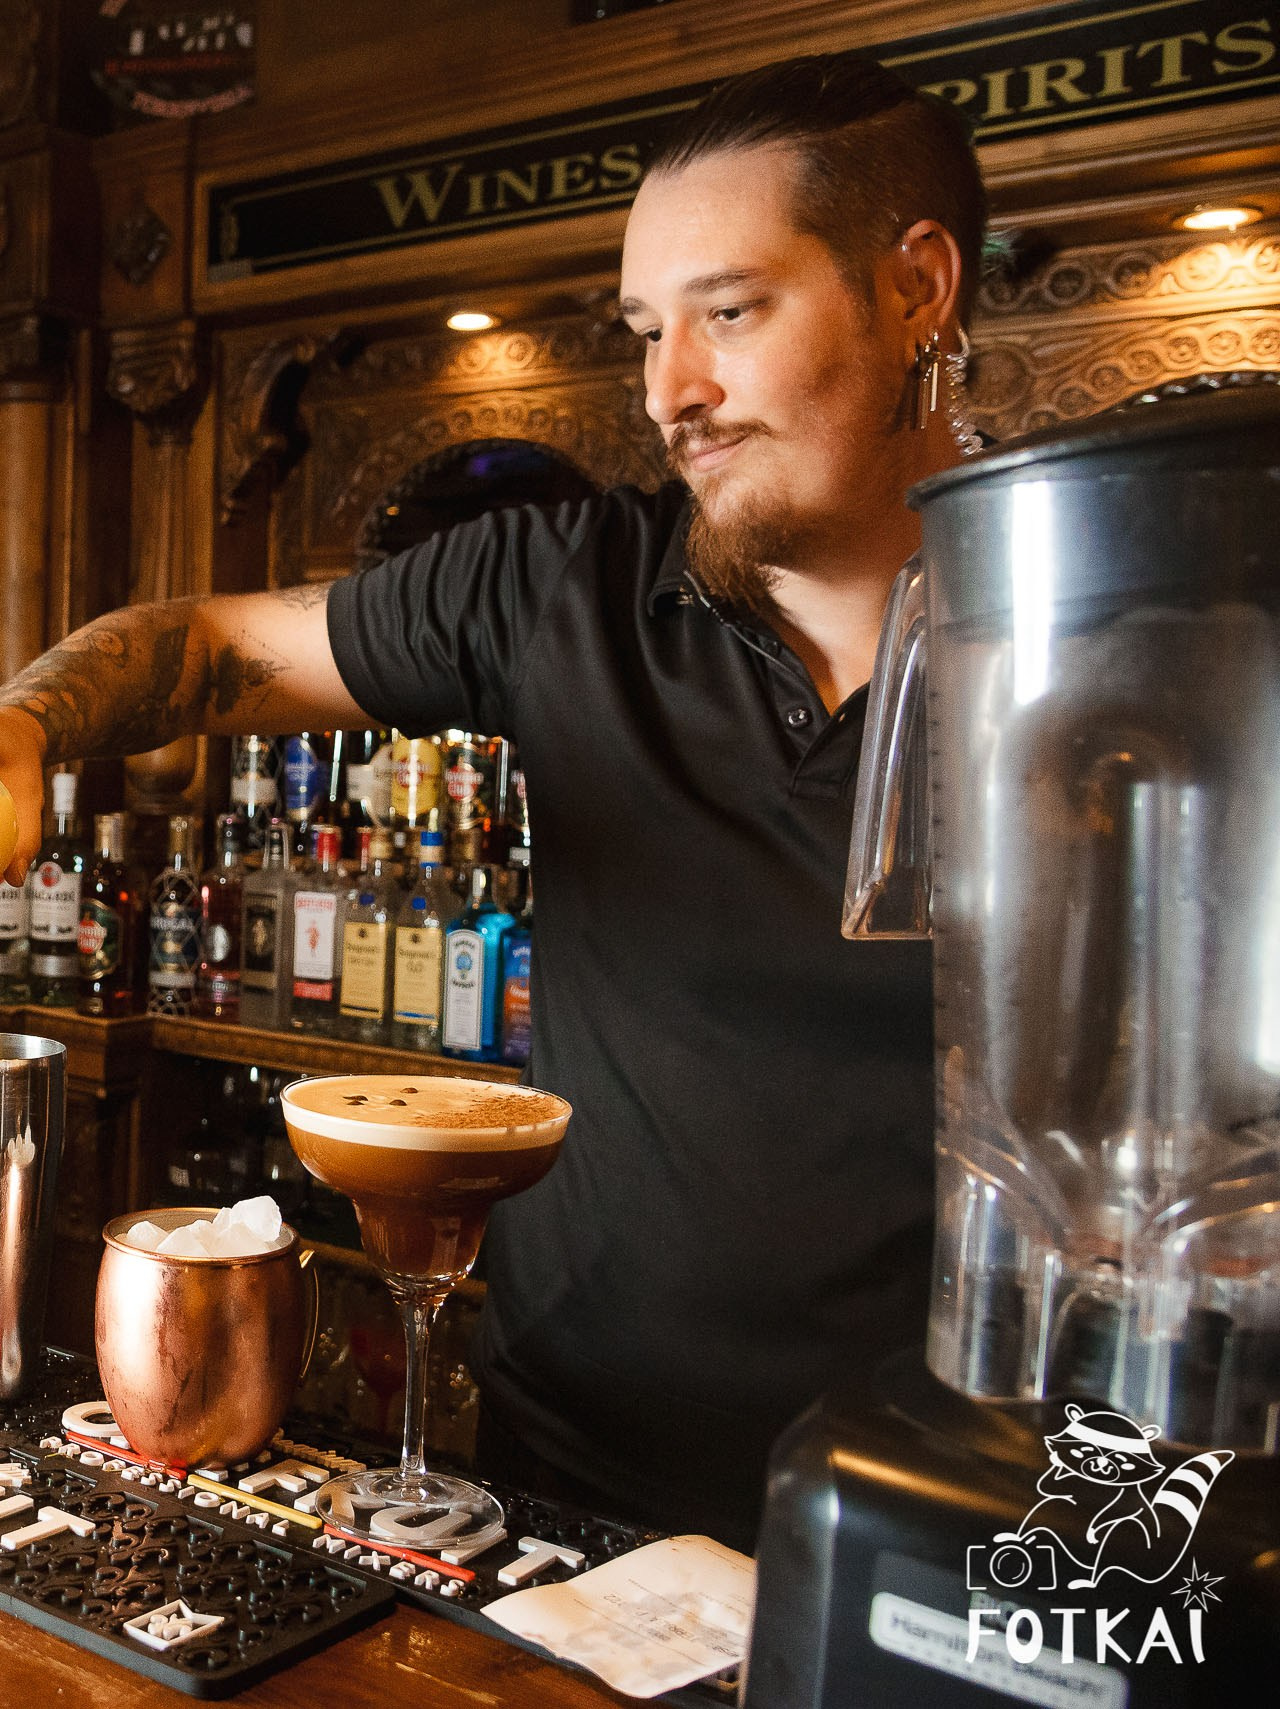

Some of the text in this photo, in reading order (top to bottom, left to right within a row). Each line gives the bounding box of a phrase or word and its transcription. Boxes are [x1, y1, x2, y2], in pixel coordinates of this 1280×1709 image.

[372, 18, 1277, 229] WINES PIRITS
[39, 1436, 467, 1597] PROFESSIONAL MIXERS
[62, 1401, 587, 1587] OFRUIT
